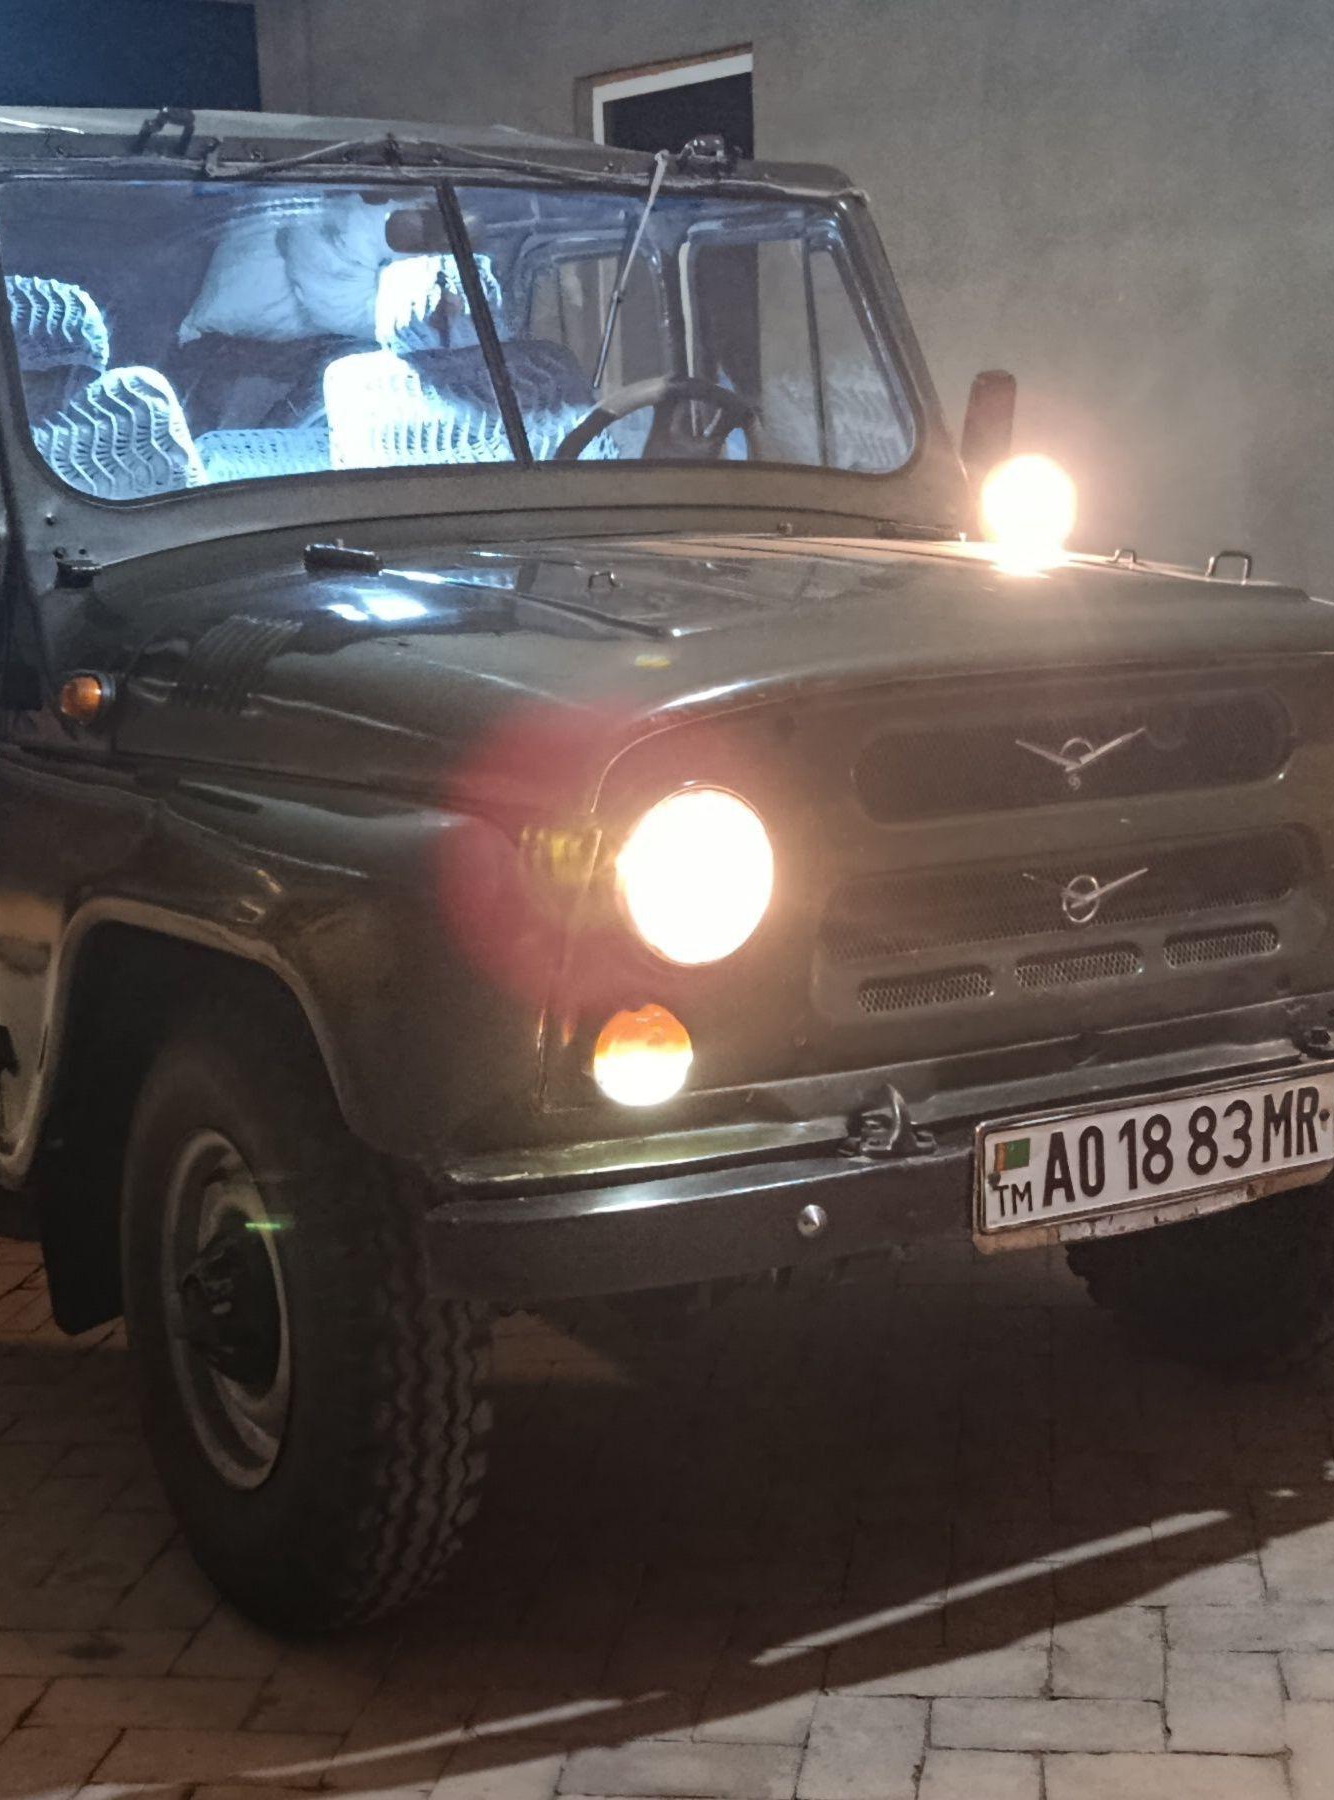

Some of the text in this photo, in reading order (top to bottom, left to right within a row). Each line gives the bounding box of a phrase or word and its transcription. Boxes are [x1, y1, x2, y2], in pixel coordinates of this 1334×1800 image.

[1119, 1113, 1174, 1191] 18
[1188, 1099, 1253, 1176] 83
[1262, 1086, 1319, 1163] MR
[992, 1180, 1034, 1218] TM
